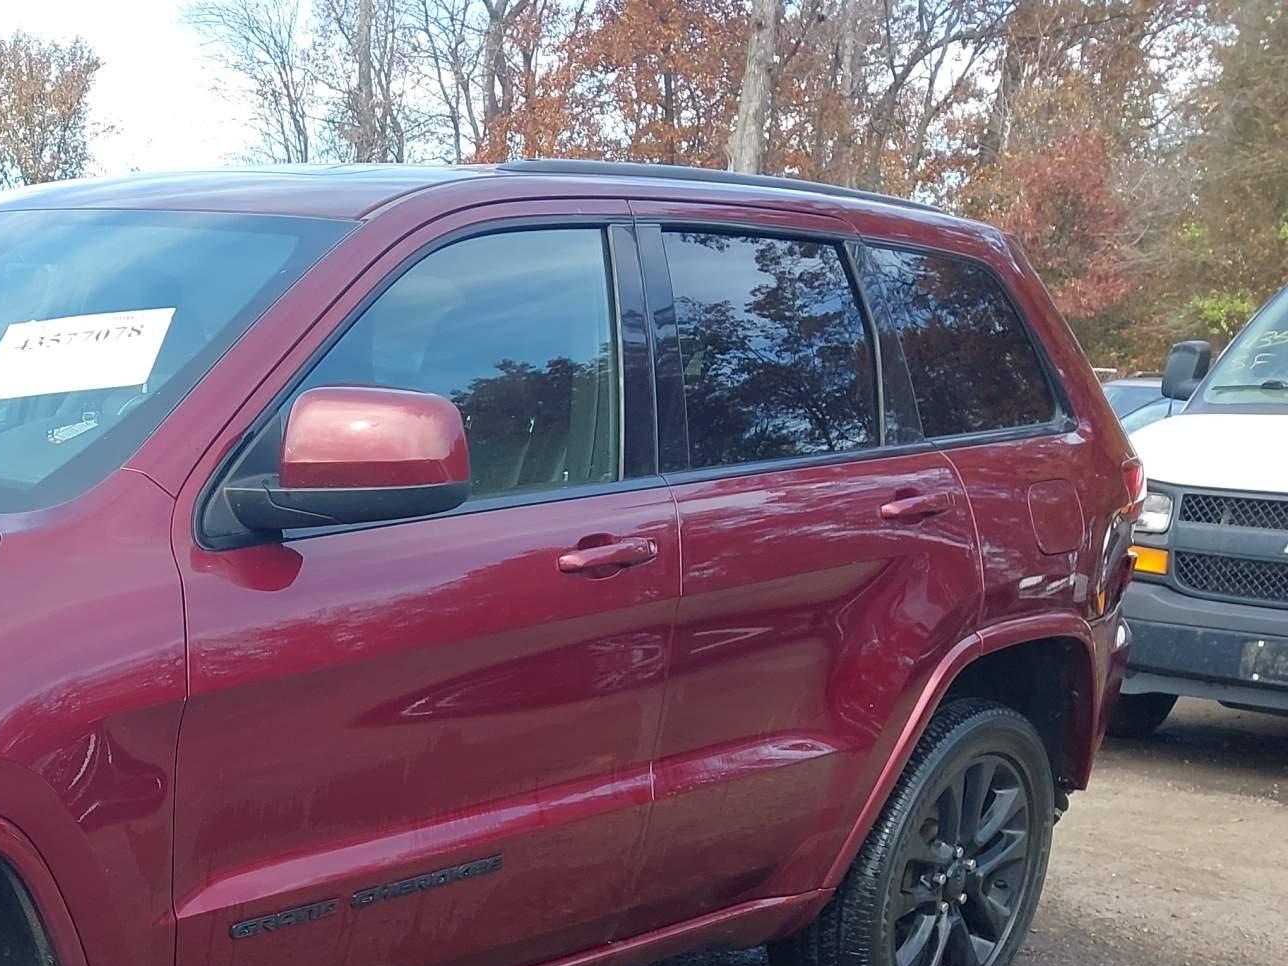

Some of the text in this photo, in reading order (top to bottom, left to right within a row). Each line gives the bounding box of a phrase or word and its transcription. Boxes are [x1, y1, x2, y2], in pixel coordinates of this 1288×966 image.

[14, 323, 144, 351] 43577078
[230, 854, 504, 940] GRAND CHEROKEE
